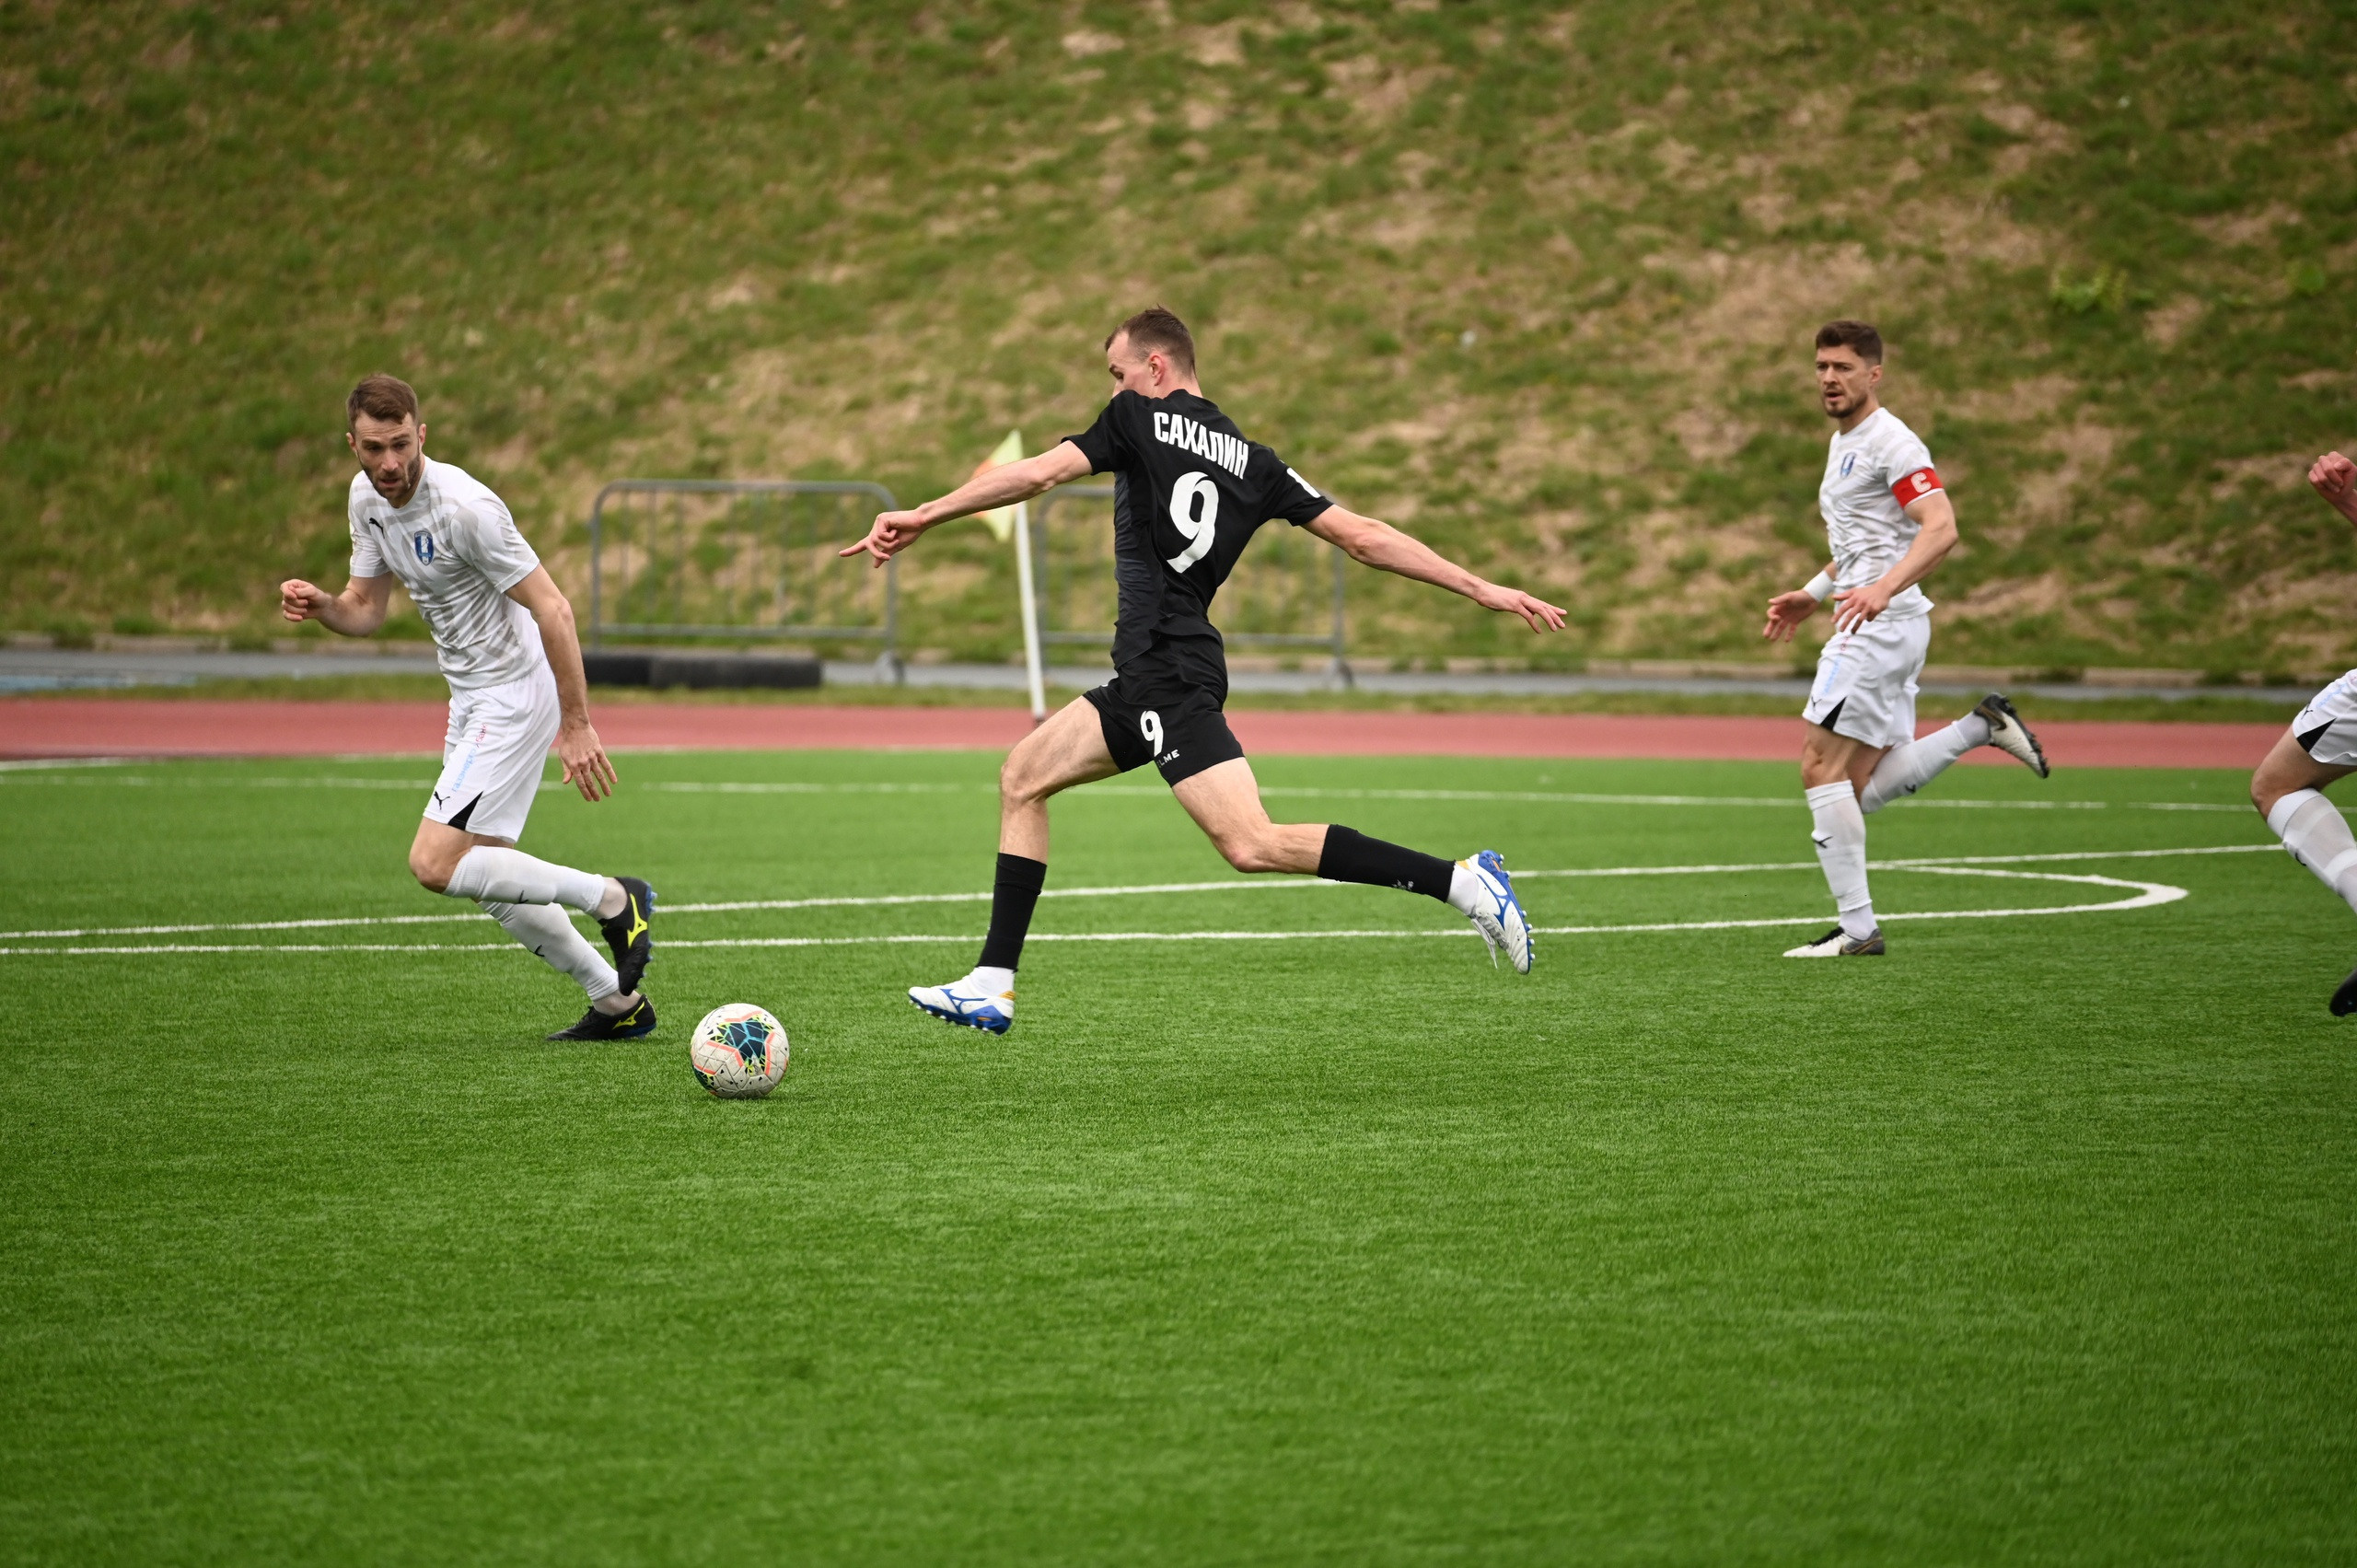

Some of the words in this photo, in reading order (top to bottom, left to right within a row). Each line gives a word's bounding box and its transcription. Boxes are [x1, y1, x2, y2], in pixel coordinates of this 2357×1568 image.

[1154, 412, 1248, 480] САХАЛИН
[1910, 471, 1933, 494] C
[1167, 471, 1219, 573] 9
[1140, 710, 1164, 757] 9
